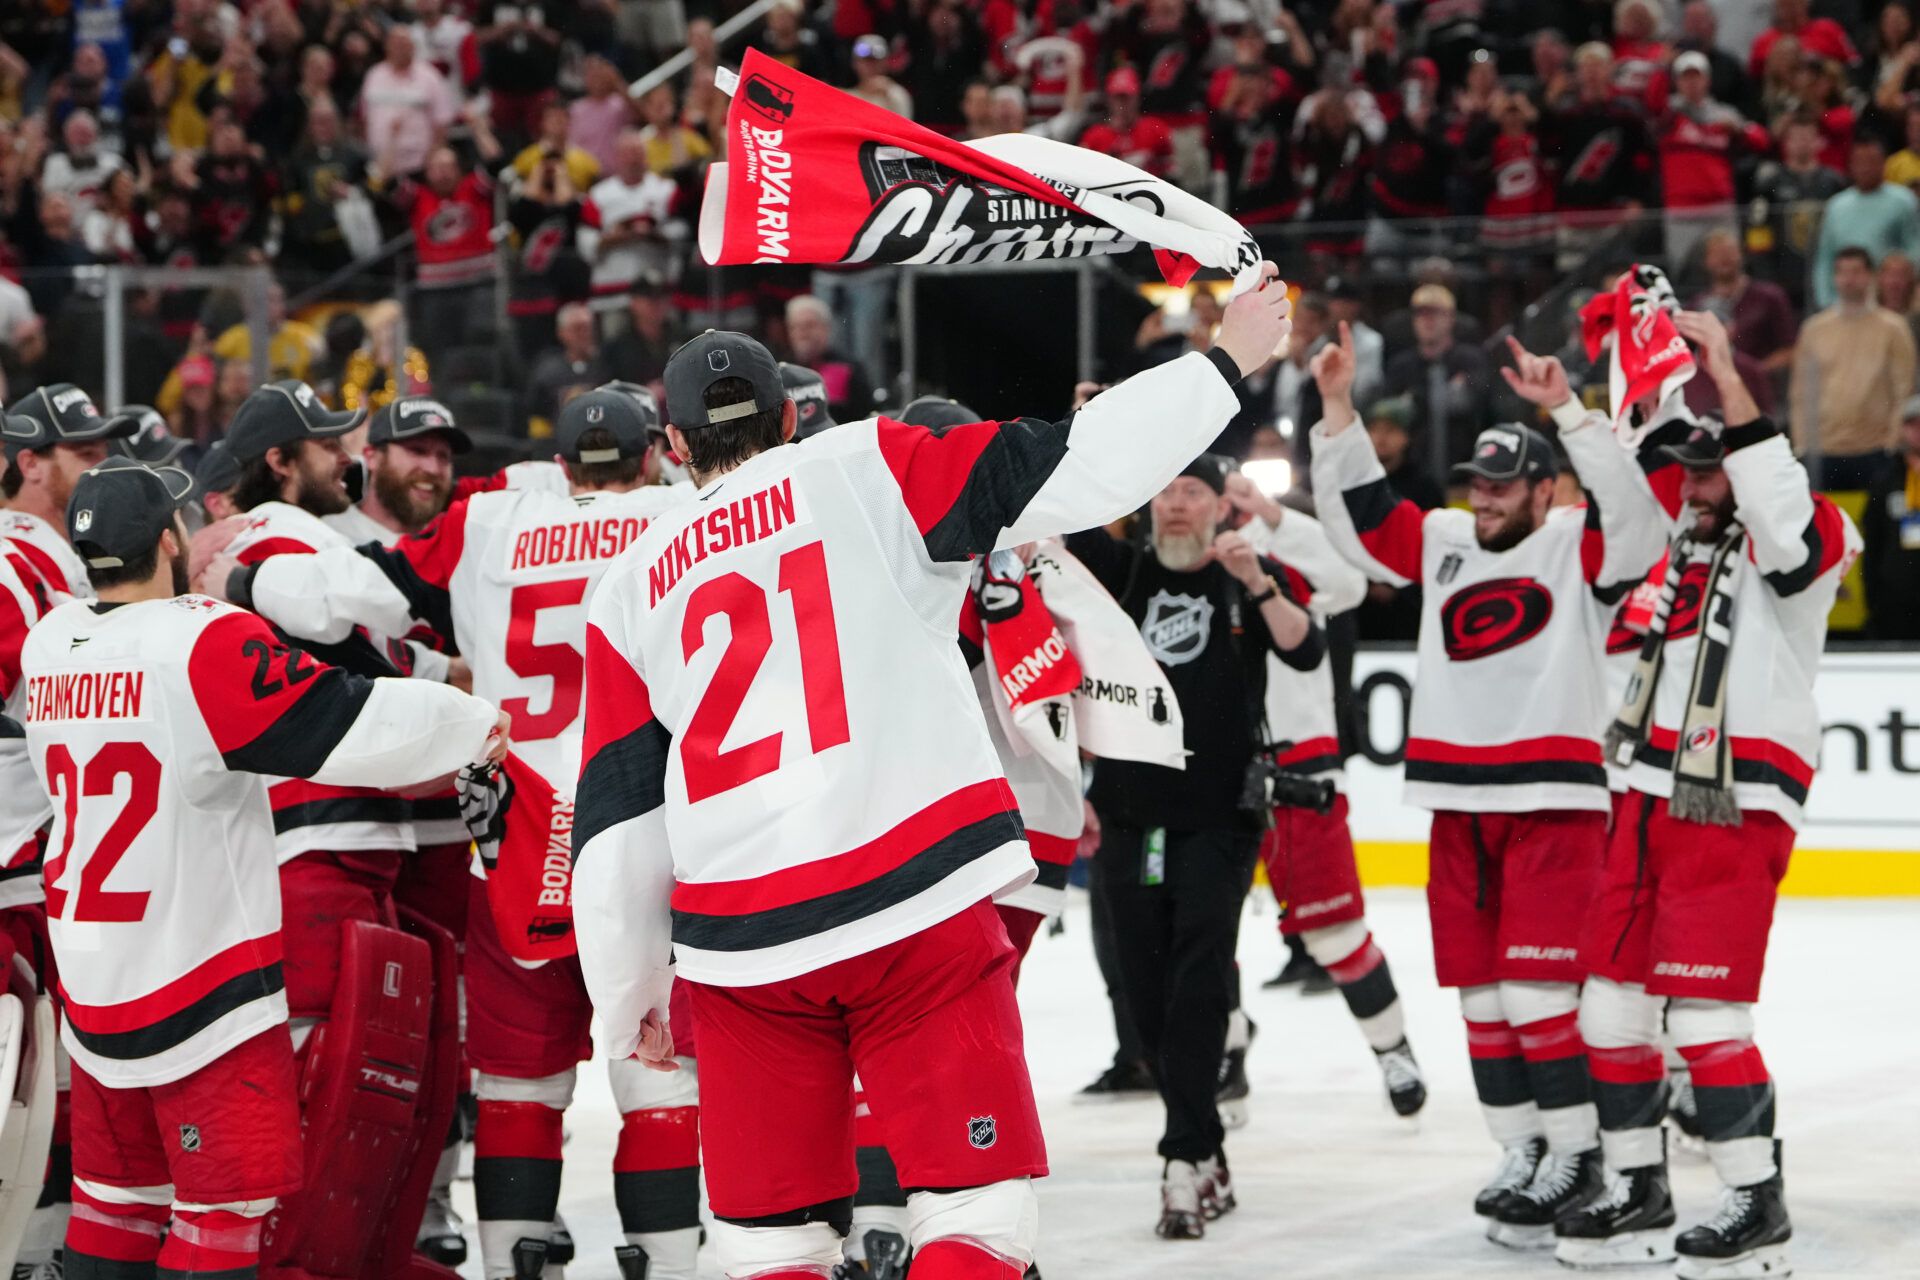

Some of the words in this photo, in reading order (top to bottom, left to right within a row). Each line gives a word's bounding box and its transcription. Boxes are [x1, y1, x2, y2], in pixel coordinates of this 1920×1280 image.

[746, 149, 758, 183] DRINK
[649, 477, 796, 611] NIKISHIN
[1154, 608, 1201, 646] NHL
[242, 640, 316, 701] 22
[680, 540, 851, 805] 21
[26, 671, 144, 722] STANKOVEN
[43, 742, 163, 923] 22
[1506, 945, 1578, 962] BAUER
[1653, 961, 1730, 979] BAUER
